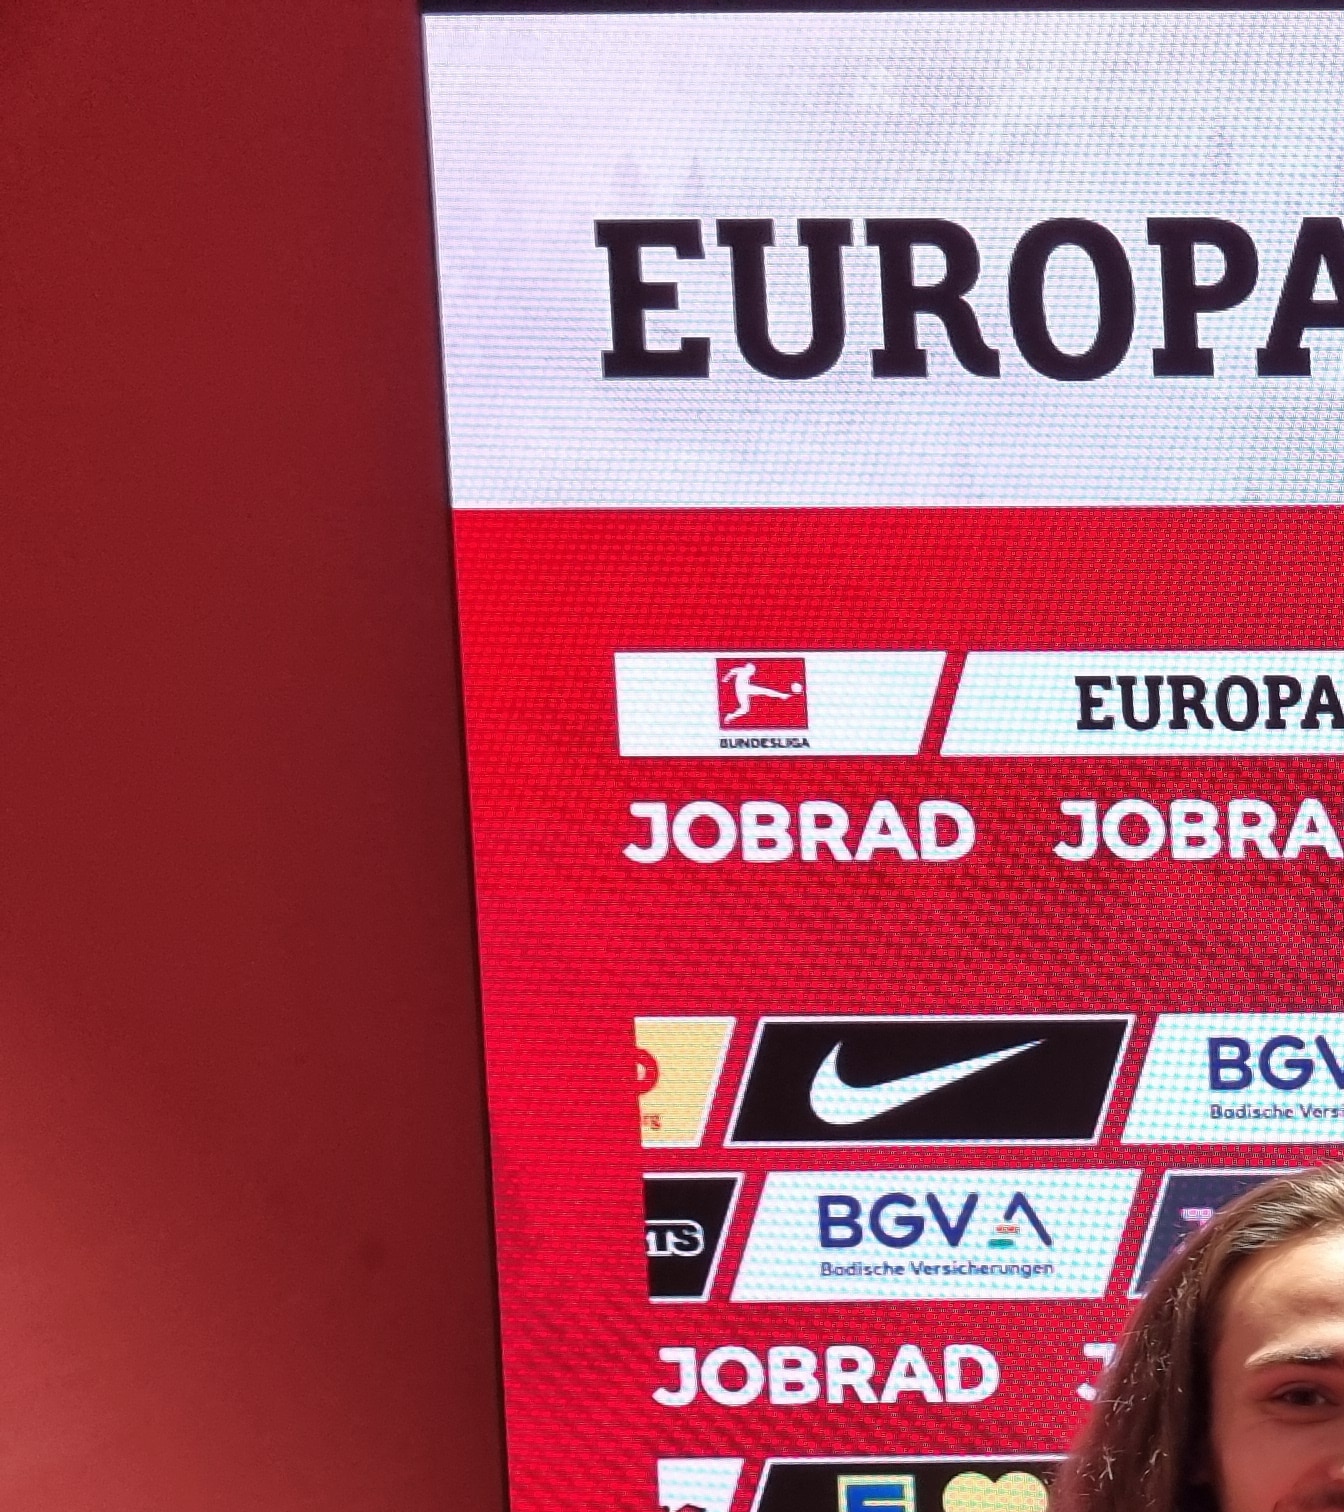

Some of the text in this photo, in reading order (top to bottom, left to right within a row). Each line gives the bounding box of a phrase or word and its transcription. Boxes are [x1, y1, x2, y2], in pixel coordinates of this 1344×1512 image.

[719, 738, 811, 750] BUNDESLIGA
[623, 800, 976, 864] JOBRAD
[1210, 1103, 1295, 1120] Badische
[819, 1260, 1054, 1279] Badische Versicherungen
[653, 1343, 1000, 1407] JOBRAD
